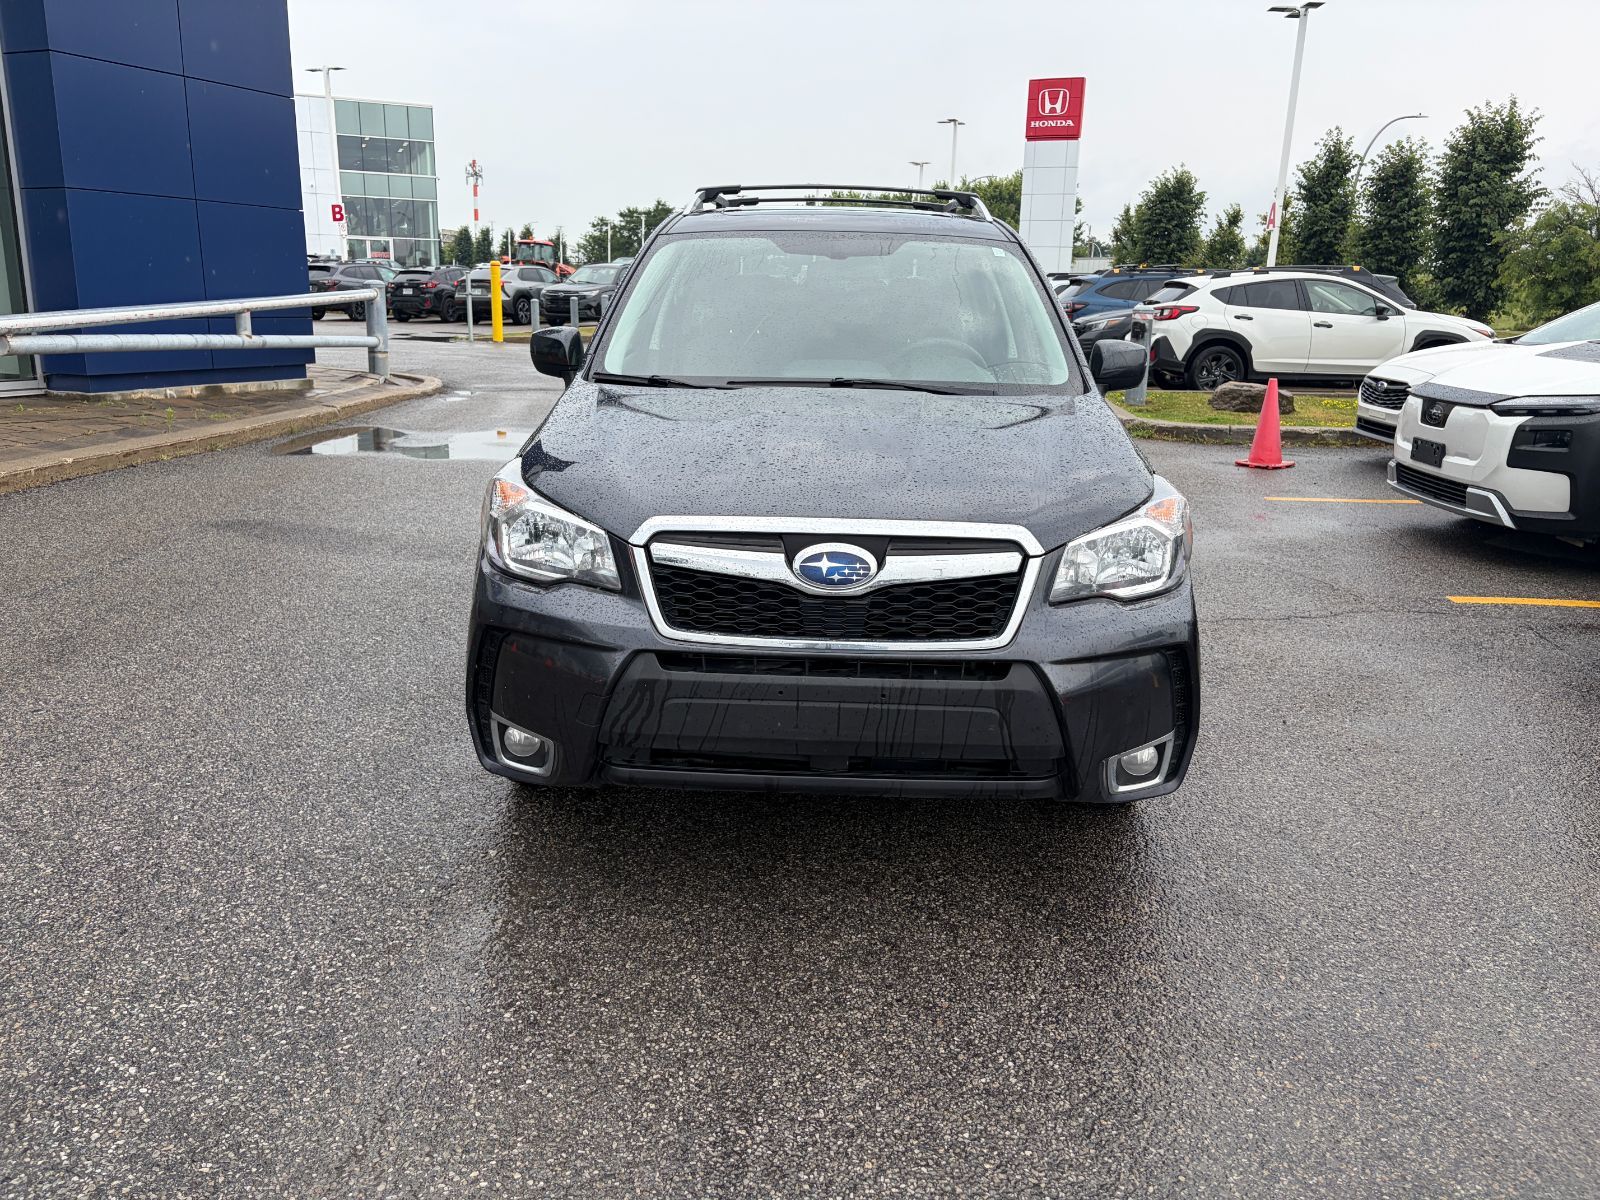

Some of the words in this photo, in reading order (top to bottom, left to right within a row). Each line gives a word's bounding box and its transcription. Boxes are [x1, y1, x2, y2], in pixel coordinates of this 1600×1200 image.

[1030, 119, 1075, 128] HONDA
[331, 204, 345, 221] B
[1266, 202, 1276, 229] A
